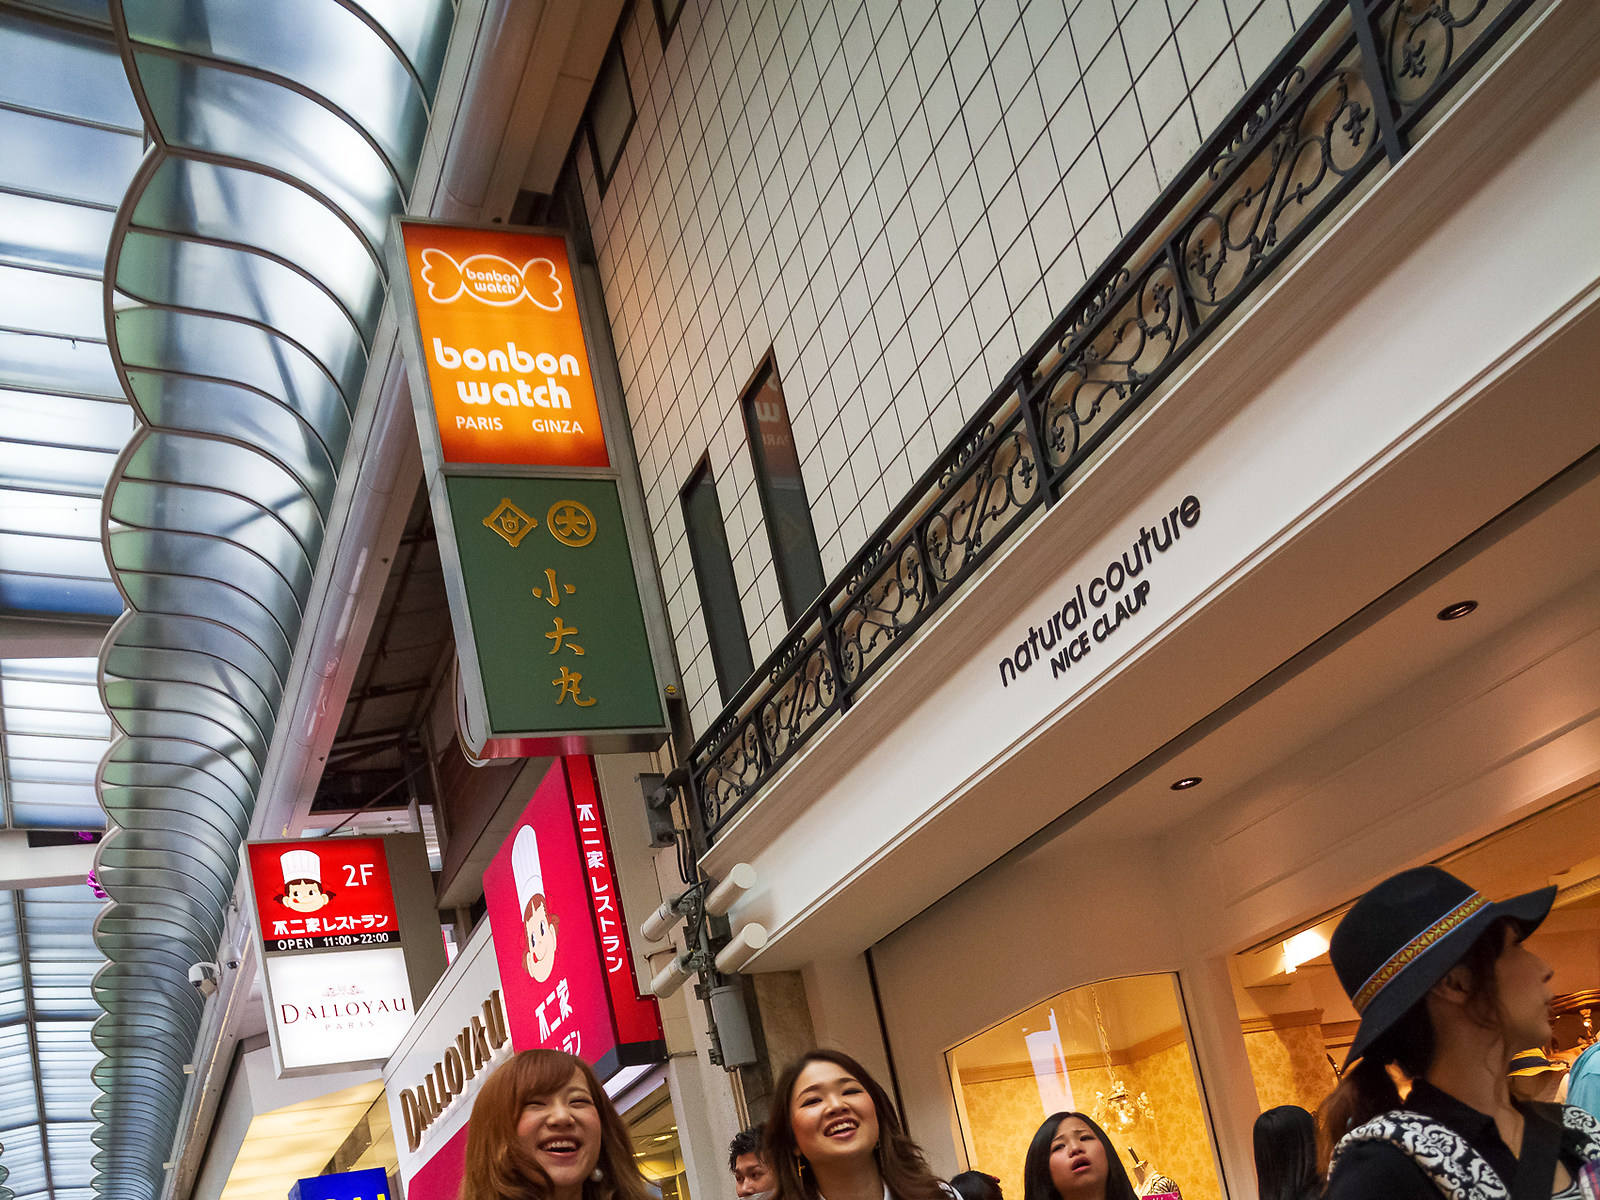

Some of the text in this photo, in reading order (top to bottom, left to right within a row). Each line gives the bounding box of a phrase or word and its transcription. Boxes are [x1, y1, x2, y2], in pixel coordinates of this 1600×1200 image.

[466, 267, 519, 285] bonbon
[474, 281, 516, 295] watch
[433, 337, 580, 377] bonbon
[456, 377, 572, 409] watch
[455, 416, 584, 434] PARIS GINZA
[998, 495, 1201, 688] natural couture
[532, 567, 597, 707] 小大丸
[1050, 580, 1150, 679] NICE CLAUP
[342, 864, 374, 887] 2F
[576, 803, 623, 974] 不二家レストラン
[272, 914, 388, 936] 不二家レストラン
[277, 932, 389, 951] OPEN 11:00 22:00
[281, 997, 407, 1025] DALLOYAU
[325, 1020, 375, 1031] PARIS
[535, 977, 573, 1044] 不二家
[399, 989, 509, 1154] DALLOYAU
